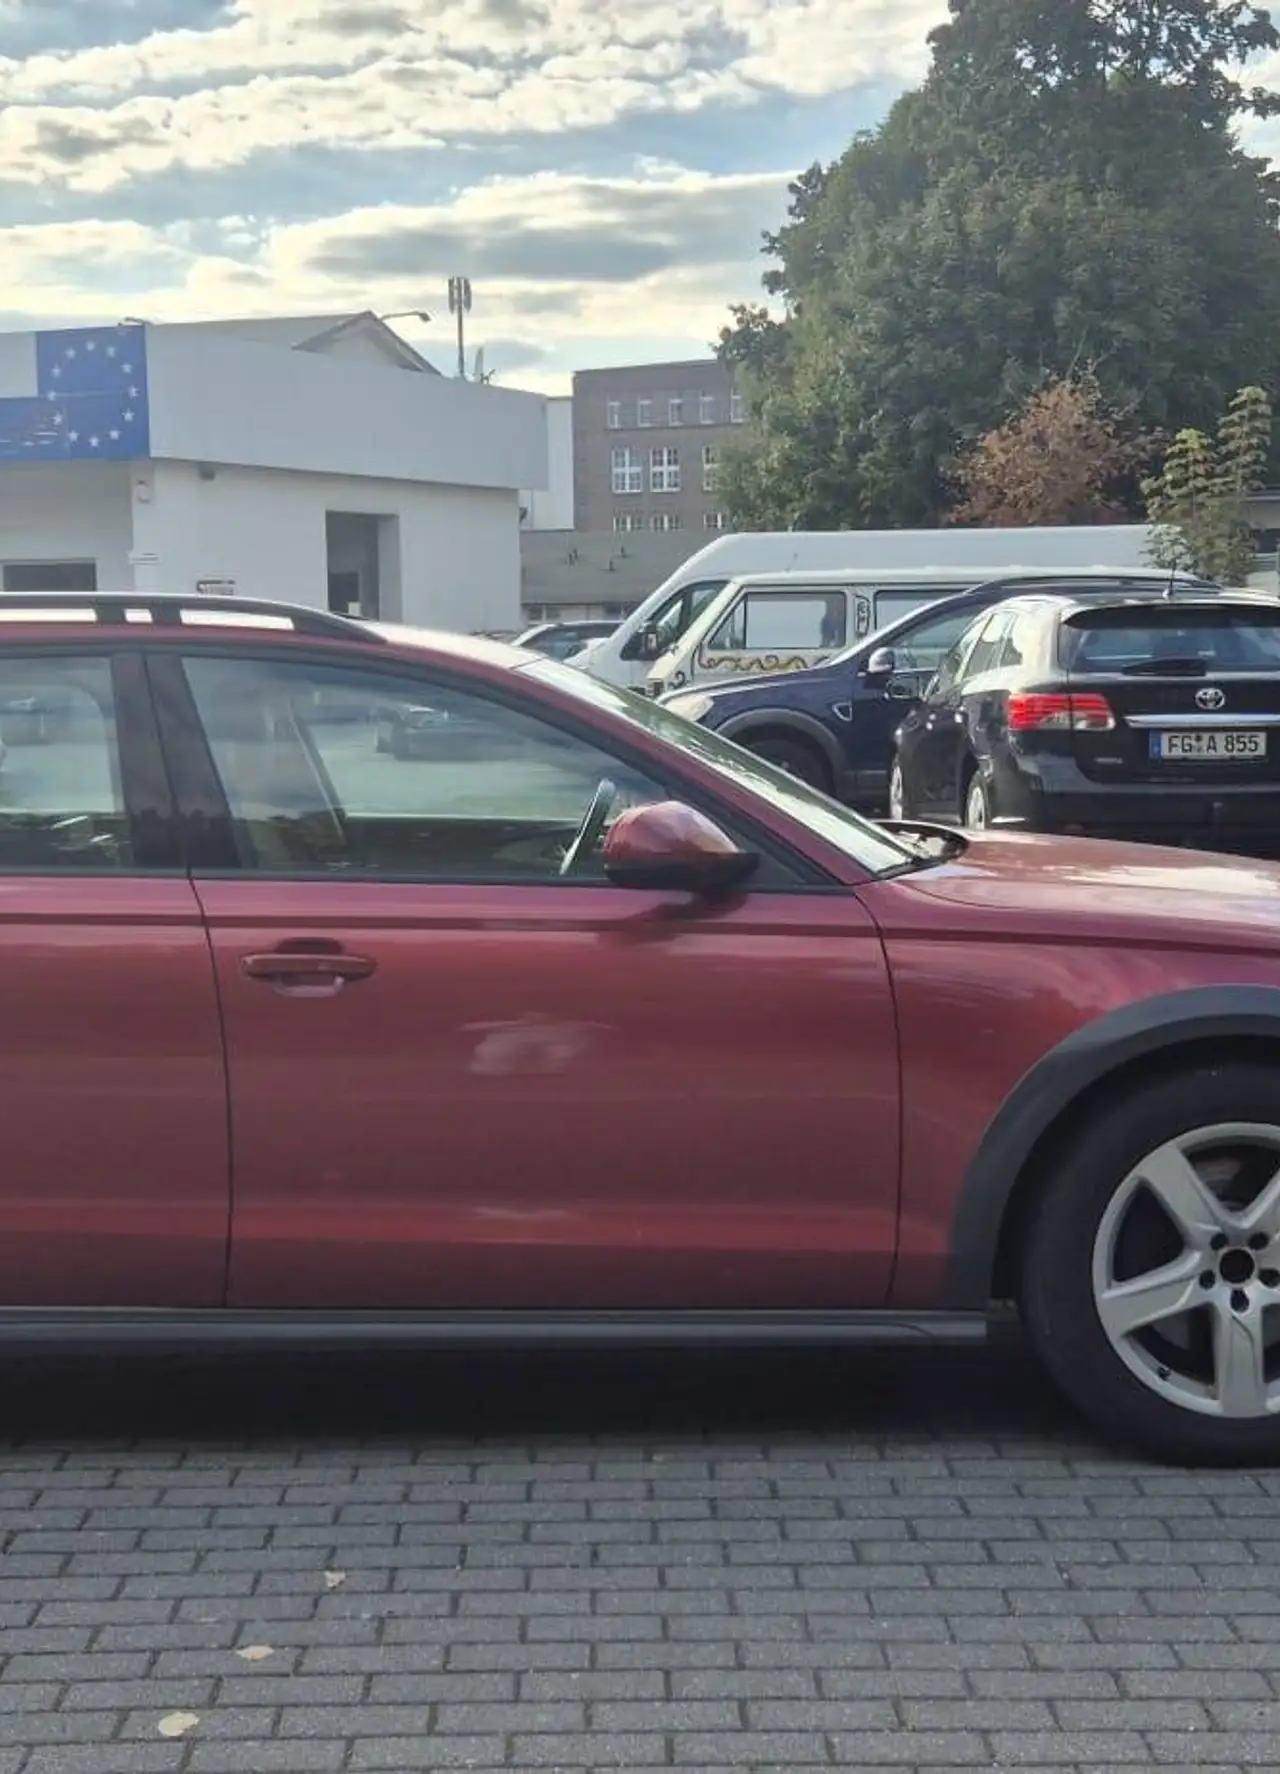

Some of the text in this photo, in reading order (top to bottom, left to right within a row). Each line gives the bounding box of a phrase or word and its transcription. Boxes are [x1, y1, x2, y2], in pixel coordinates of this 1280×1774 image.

[1168, 734, 1260, 753] FG A 855
